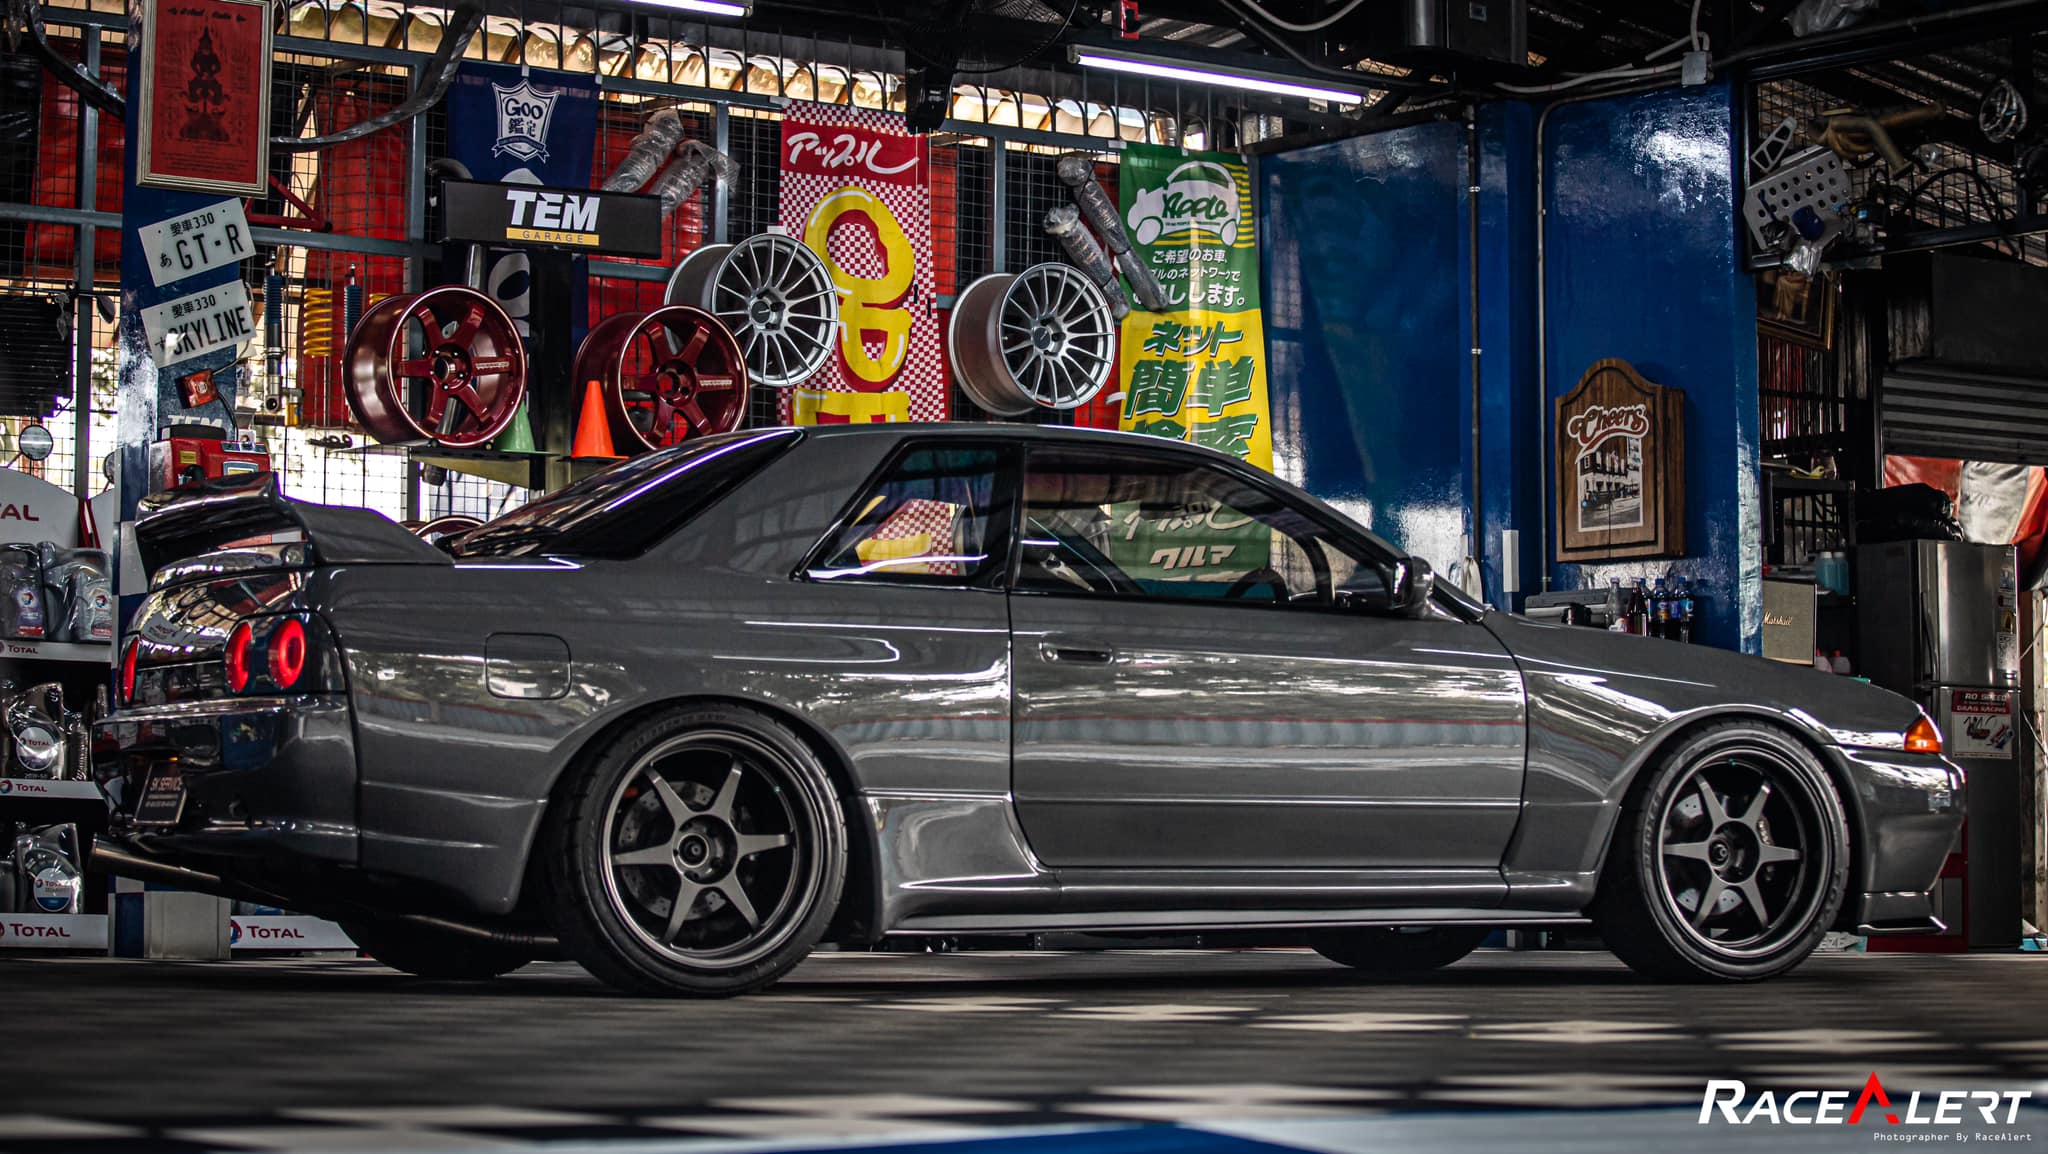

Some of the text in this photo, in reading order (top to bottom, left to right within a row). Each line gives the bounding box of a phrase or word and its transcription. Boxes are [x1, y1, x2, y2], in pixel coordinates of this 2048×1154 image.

[505, 98, 543, 119] Goo
[508, 118, 537, 137] 鑑定
[786, 131, 920, 174] アップル
[507, 189, 600, 232] TEM
[1162, 192, 1229, 220] Apple
[522, 231, 584, 244] GARAGE
[1144, 321, 1243, 357] ネット
[1124, 356, 1255, 419] 簡単
[1568, 405, 1648, 446] Cheers
[1763, 611, 1793, 626] Marshall
[8, 644, 38, 654] TOTAL
[16, 783, 48, 792] TOTAL
[10, 923, 71, 937] TOTAL
[246, 926, 304, 938] TOTAL
